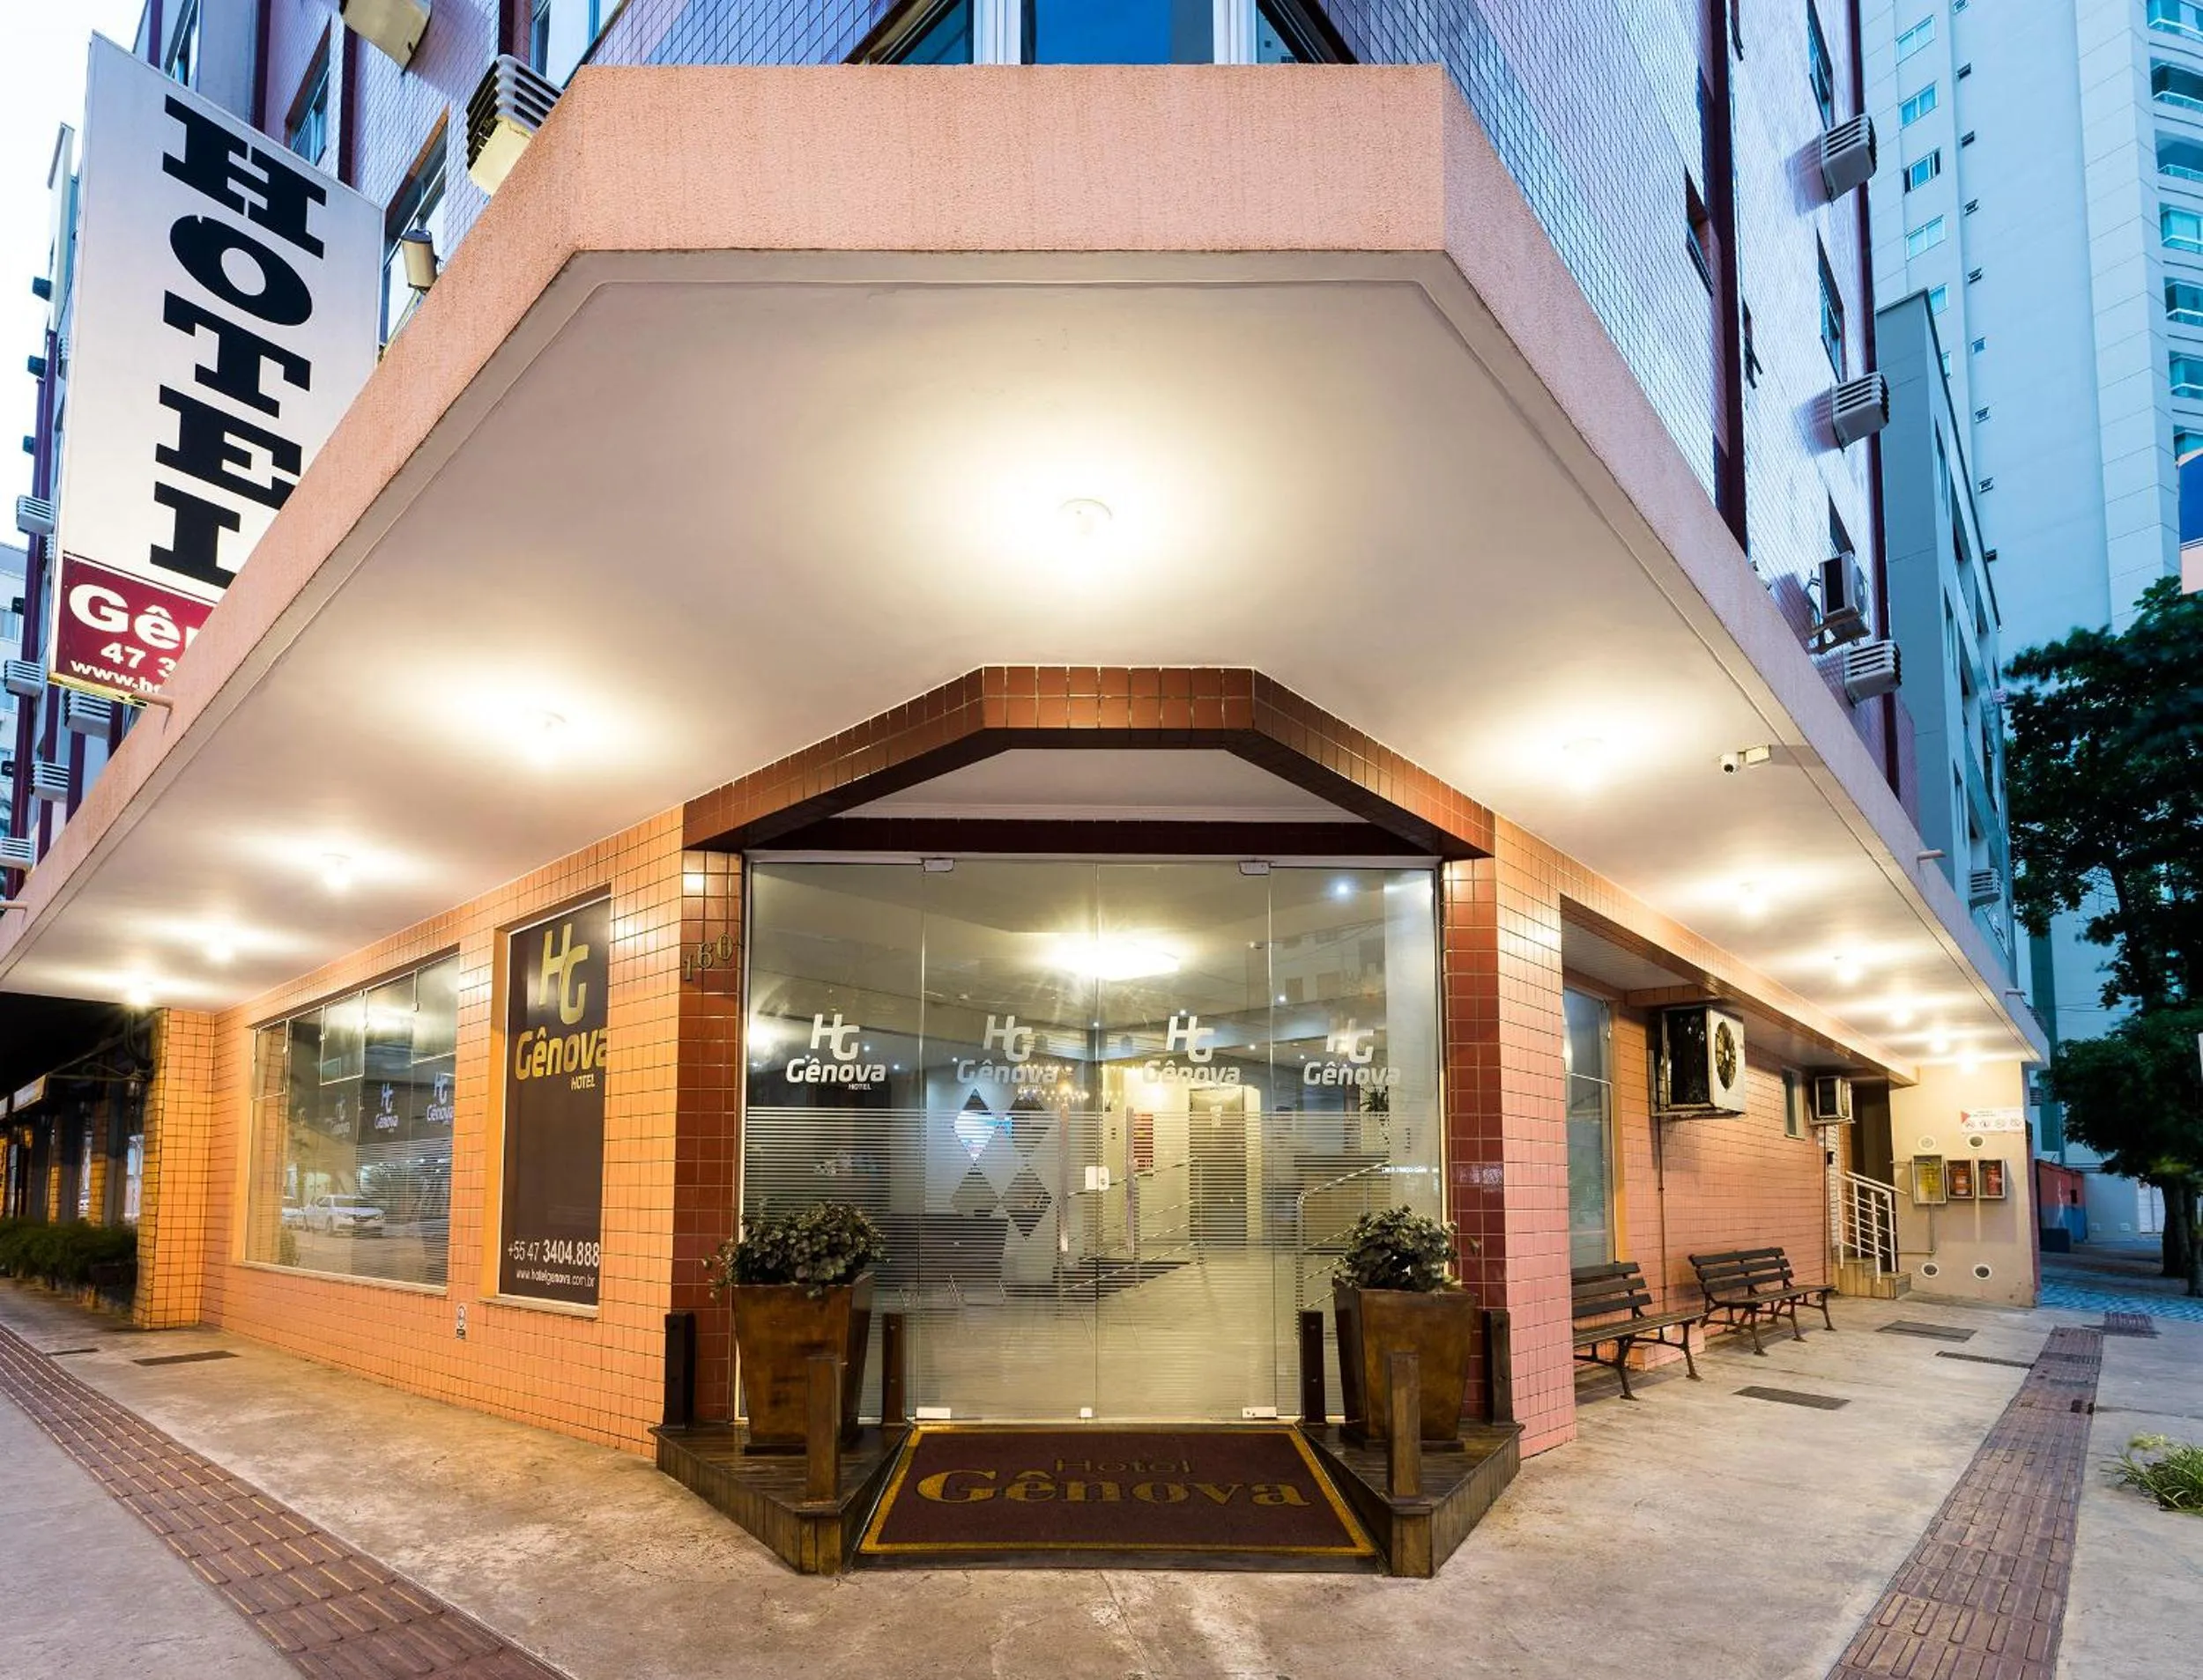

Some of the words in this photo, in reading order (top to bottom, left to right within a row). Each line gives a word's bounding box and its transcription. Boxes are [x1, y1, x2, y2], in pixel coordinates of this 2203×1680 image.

[150, 93, 326, 588] HOTEL
[69, 583, 200, 650] Gê
[100, 642, 146, 669] 47
[539, 923, 590, 1025] HG
[810, 1013, 860, 1061] HG
[983, 1015, 1033, 1062] HG
[571, 1074, 596, 1091] HOTEL
[786, 1057, 886, 1083] Gênova
[957, 1059, 1057, 1084] Gênova
[1143, 1060, 1240, 1085] Gênova
[1304, 1061, 1401, 1085] Gênova
[508, 1240, 526, 1261] +55
[527, 1241, 540, 1262] 47
[543, 1239, 600, 1267] 3404.888
[1057, 1458, 1192, 1474] Hotel
[916, 1469, 1312, 1507] Gênova
